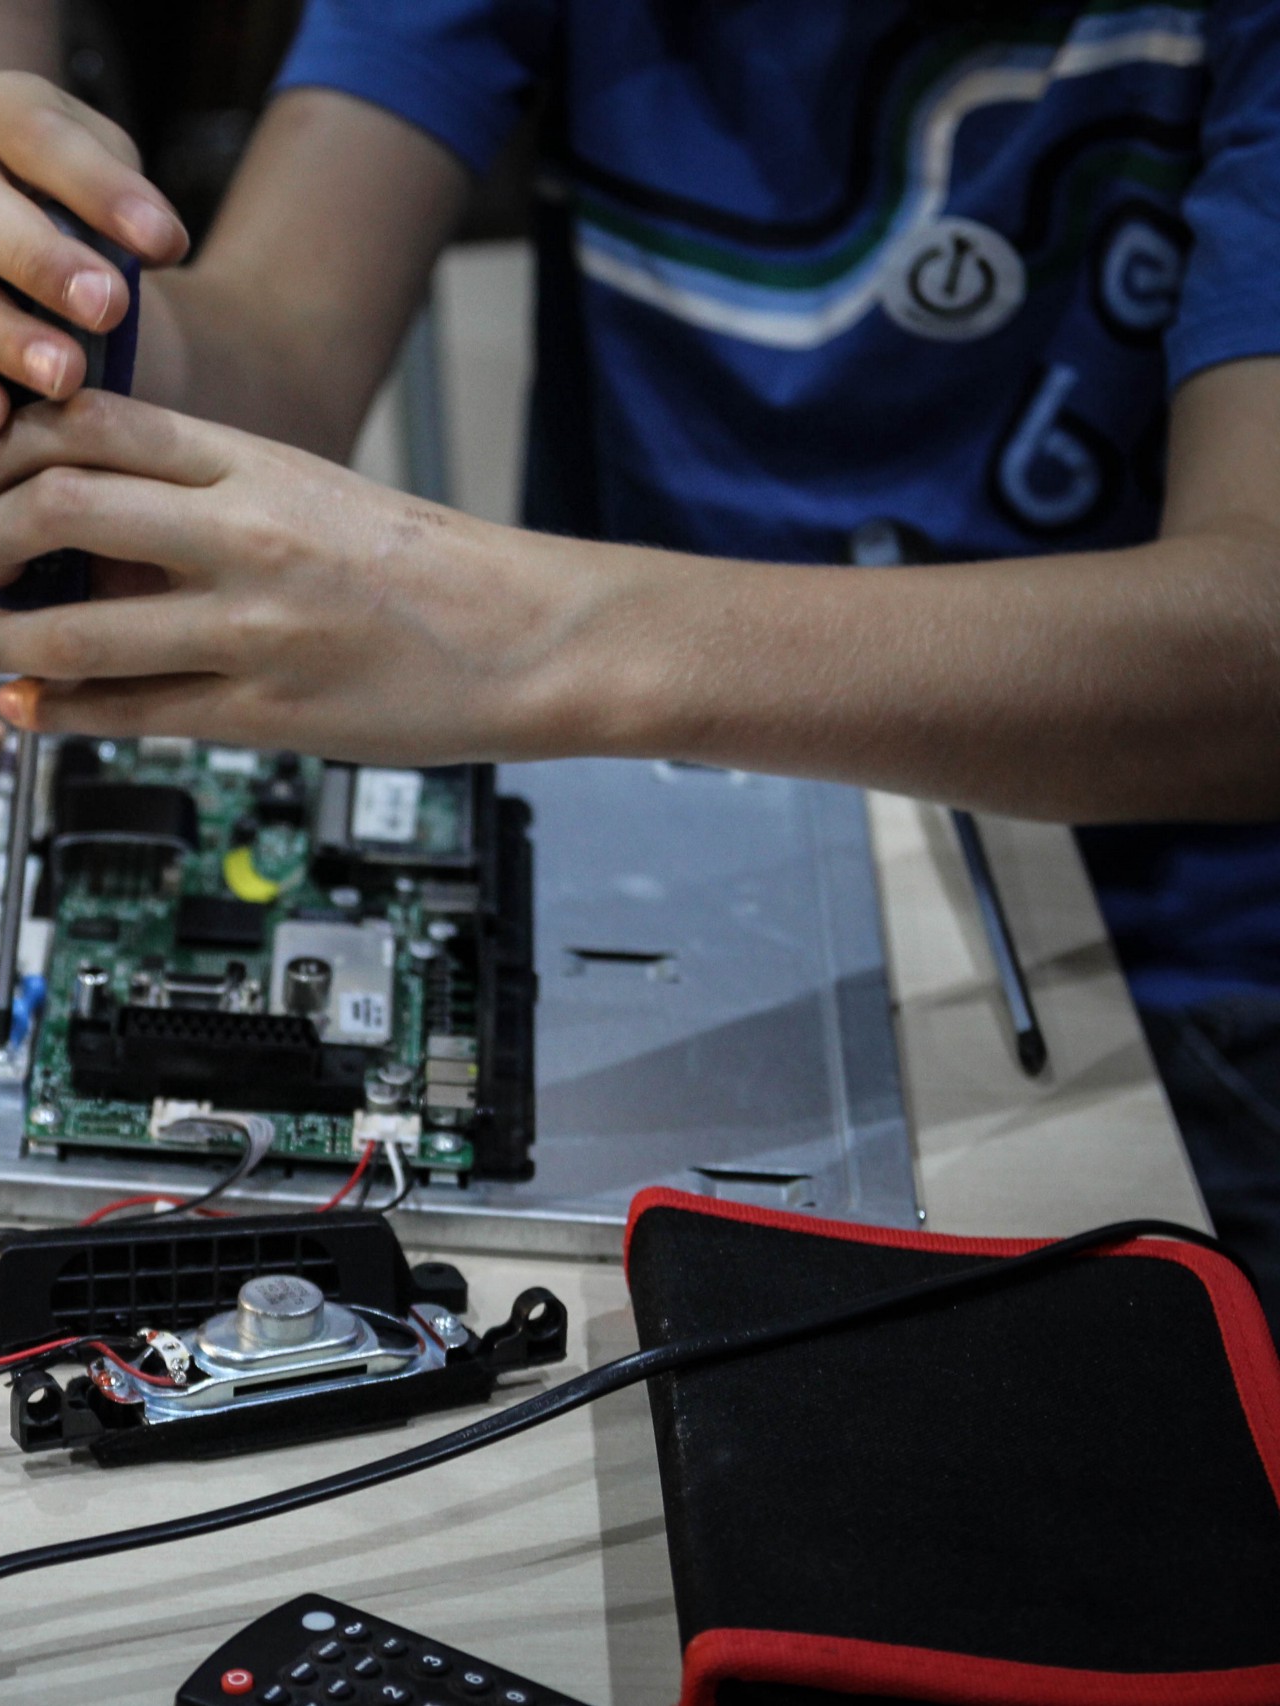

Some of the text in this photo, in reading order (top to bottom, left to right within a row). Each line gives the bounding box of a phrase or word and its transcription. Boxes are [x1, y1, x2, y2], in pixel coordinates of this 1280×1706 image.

[422, 1655, 442, 1667] 3
[464, 1672, 484, 1685] 6
[382, 1685, 404, 1699] 2
[505, 1690, 526, 1703] 9
